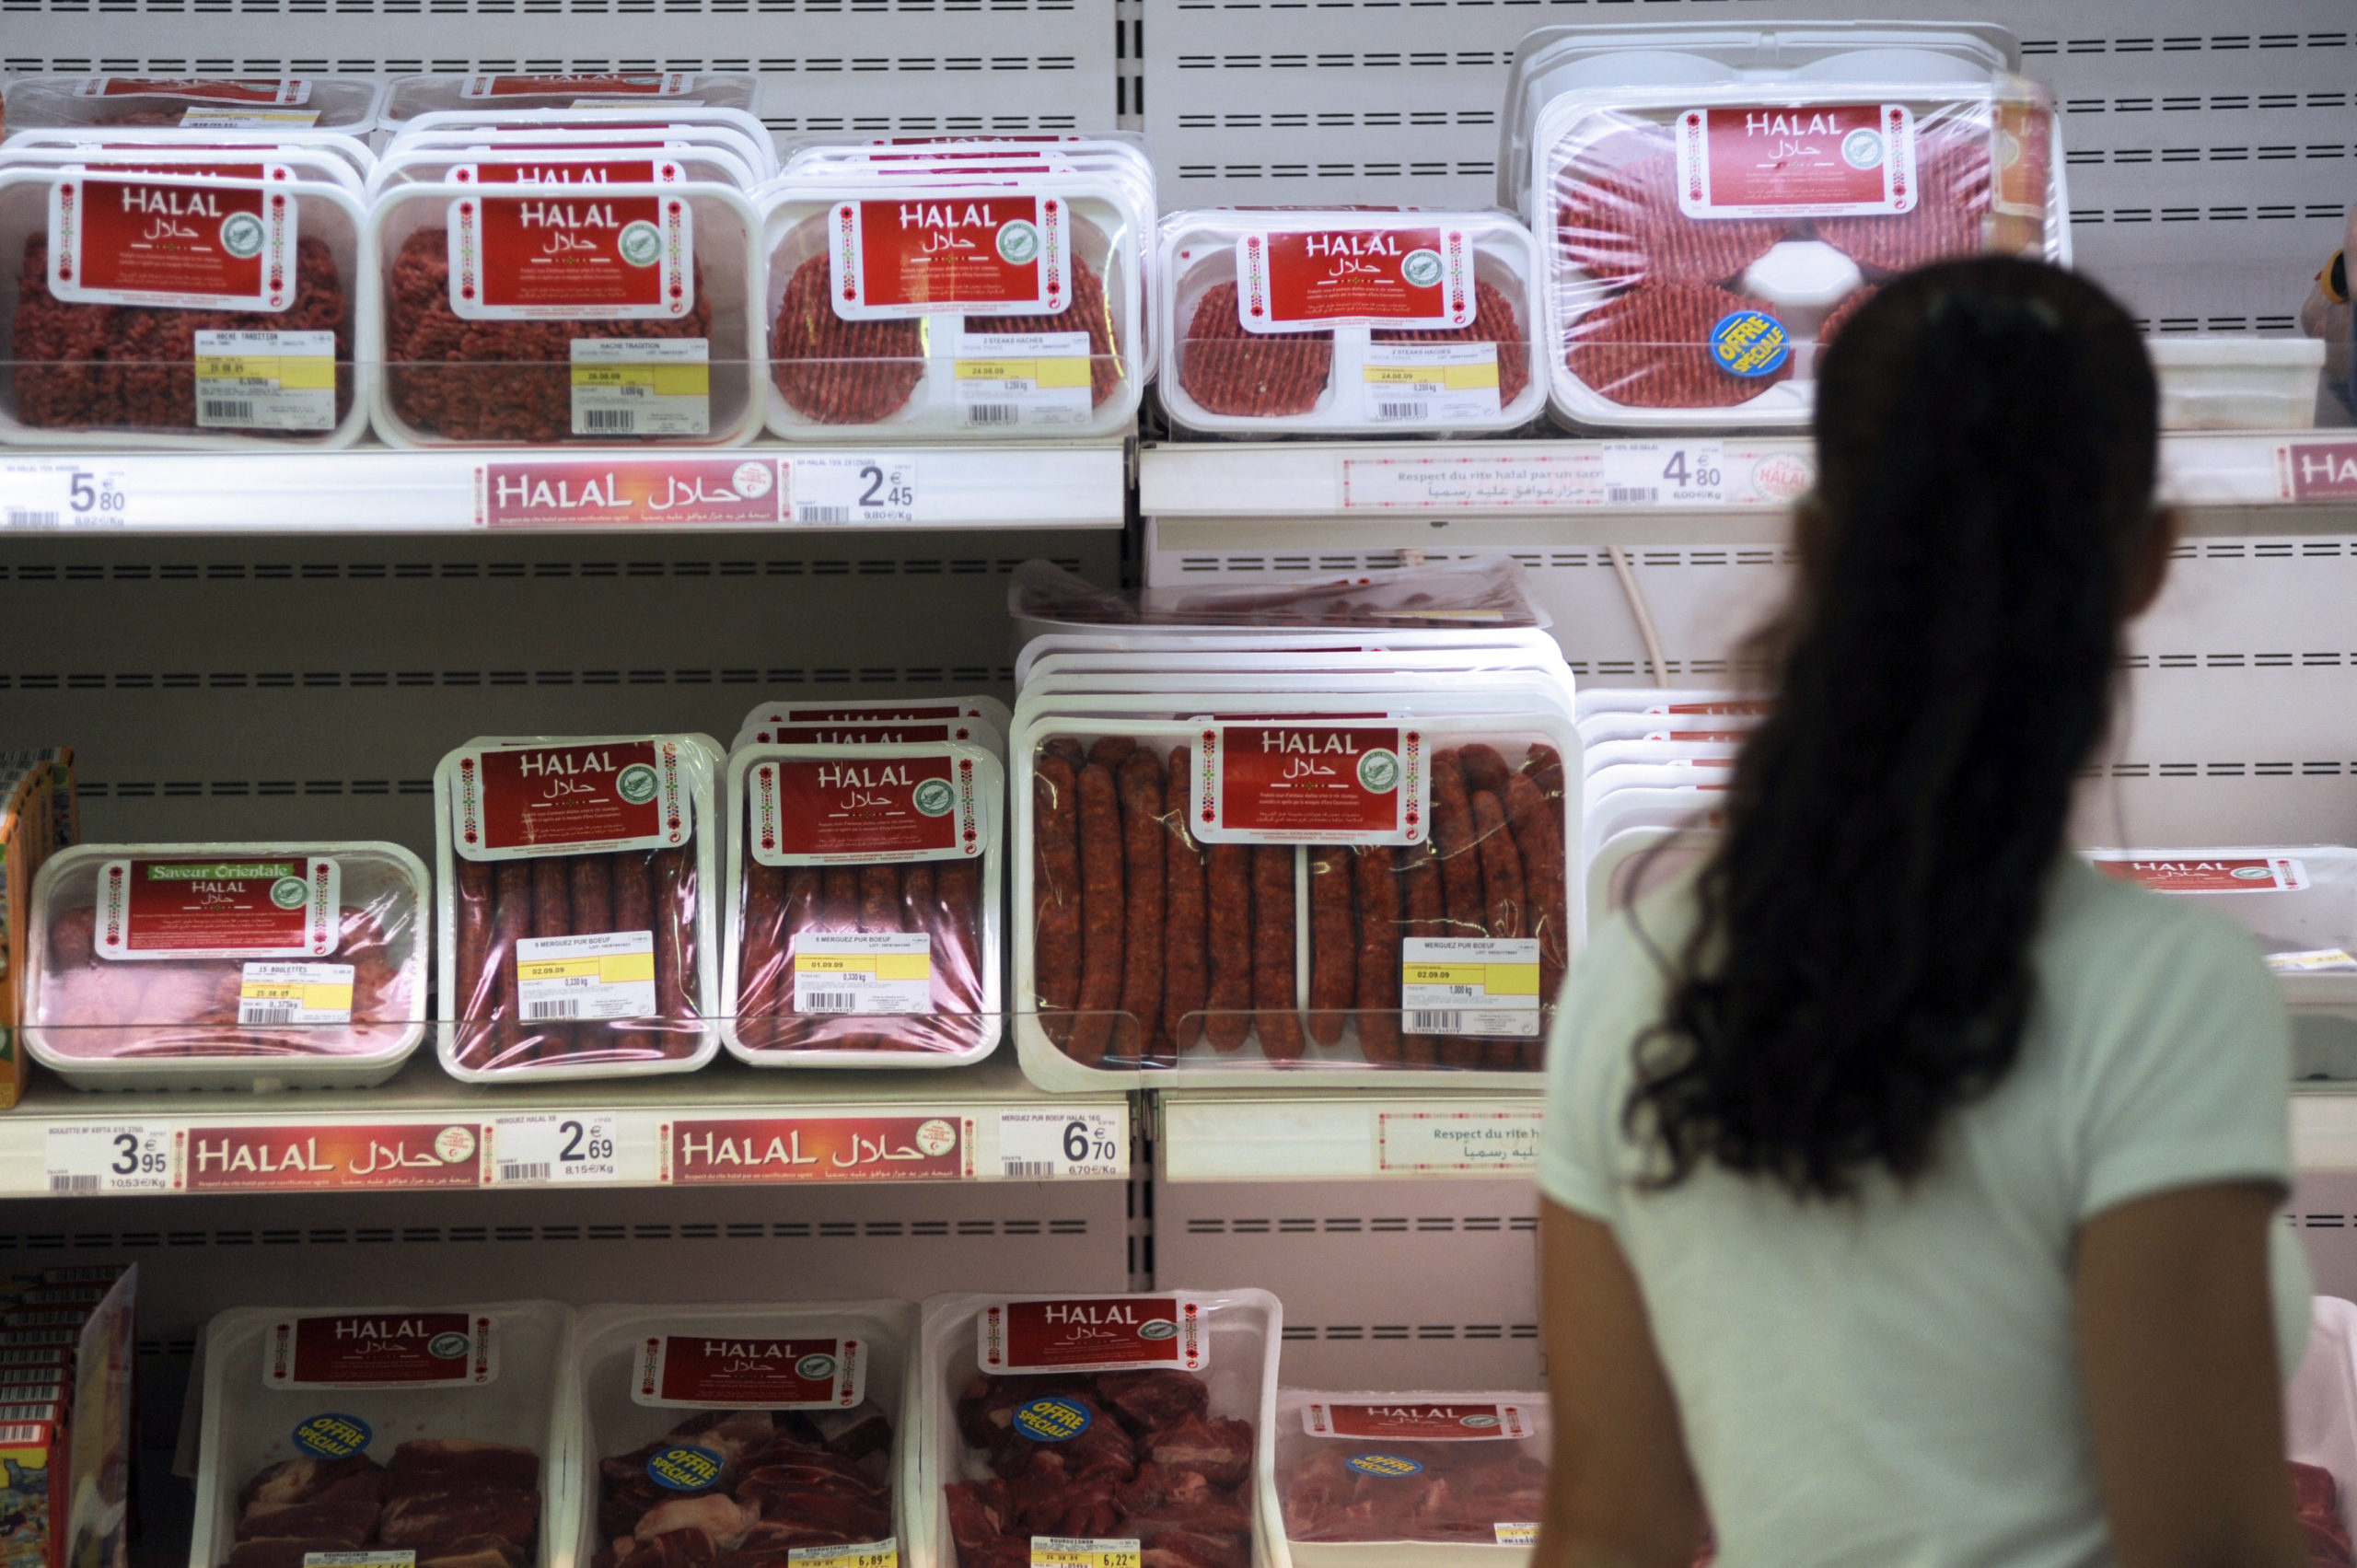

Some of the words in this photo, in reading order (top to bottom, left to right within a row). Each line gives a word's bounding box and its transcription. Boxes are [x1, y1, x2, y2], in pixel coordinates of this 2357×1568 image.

[1746, 112, 1843, 136] HALAL
[1769, 139, 1821, 159] حلال
[122, 187, 223, 217] HALAL
[520, 202, 619, 228] HALAL
[900, 203, 997, 228] HALAL
[145, 218, 199, 239] حلال
[543, 232, 597, 253] حلال
[922, 231, 975, 253] حلال
[1306, 234, 1402, 258] HALAL
[1329, 258, 1381, 276] حلال
[1719, 316, 1770, 360] OFFRE
[1398, 471, 1446, 482] Respect
[1449, 470, 1466, 480] du
[1470, 470, 1492, 480] rite
[1496, 469, 1527, 480] halal
[1531, 470, 1550, 482] par
[1555, 470, 1571, 479] un
[1663, 450, 1691, 487] 4
[1696, 469, 1721, 486] 80
[70, 472, 96, 512] 5
[100, 492, 125, 511] 80
[496, 472, 634, 508] HALAL
[648, 475, 742, 511] حلال
[859, 466, 884, 506] 2
[888, 487, 912, 505] 45
[1262, 730, 1359, 754] HALAL
[520, 751, 617, 777] HALAL
[1283, 758, 1336, 779] حلال
[818, 765, 913, 788] HALAL
[543, 778, 596, 799] حلال
[841, 791, 892, 809] حلال
[154, 865, 210, 879] Saveur
[215, 864, 288, 878] Orientale
[2132, 862, 2230, 871] HALAL
[192, 882, 246, 893] HALAL
[559, 1121, 585, 1162] 2
[590, 1125, 601, 1137] €
[1063, 1121, 1088, 1162] 6
[1094, 1128, 1106, 1139] €
[1434, 1129, 1481, 1142] Respect
[1485, 1128, 1502, 1139] du
[1505, 1129, 1527, 1139] rite
[112, 1133, 138, 1175] 3
[145, 1139, 157, 1151] €
[196, 1137, 335, 1173] HALAL
[588, 1139, 612, 1159] 69
[681, 1131, 819, 1167] HALAL
[831, 1133, 924, 1168] حلال
[1092, 1141, 1116, 1160] 70
[142, 1154, 166, 1172] 95
[349, 1140, 444, 1175] حلال
[1045, 1305, 1139, 1324] HALAL
[335, 1319, 430, 1340] HALAL
[1066, 1327, 1118, 1341] حلال
[355, 1340, 407, 1353] حلال
[704, 1341, 797, 1358] HALAL
[724, 1360, 775, 1372] حلال
[1032, 1401, 1085, 1429] OFFRE
[1367, 1407, 1459, 1419] HALAL
[312, 1418, 366, 1447] OFFRE
[668, 1449, 718, 1480] OFFRE
[1365, 1456, 1417, 1473] OFFRE
[859, 1555, 882, 1567] 6,89
[1104, 1554, 1127, 1566] 6,22
